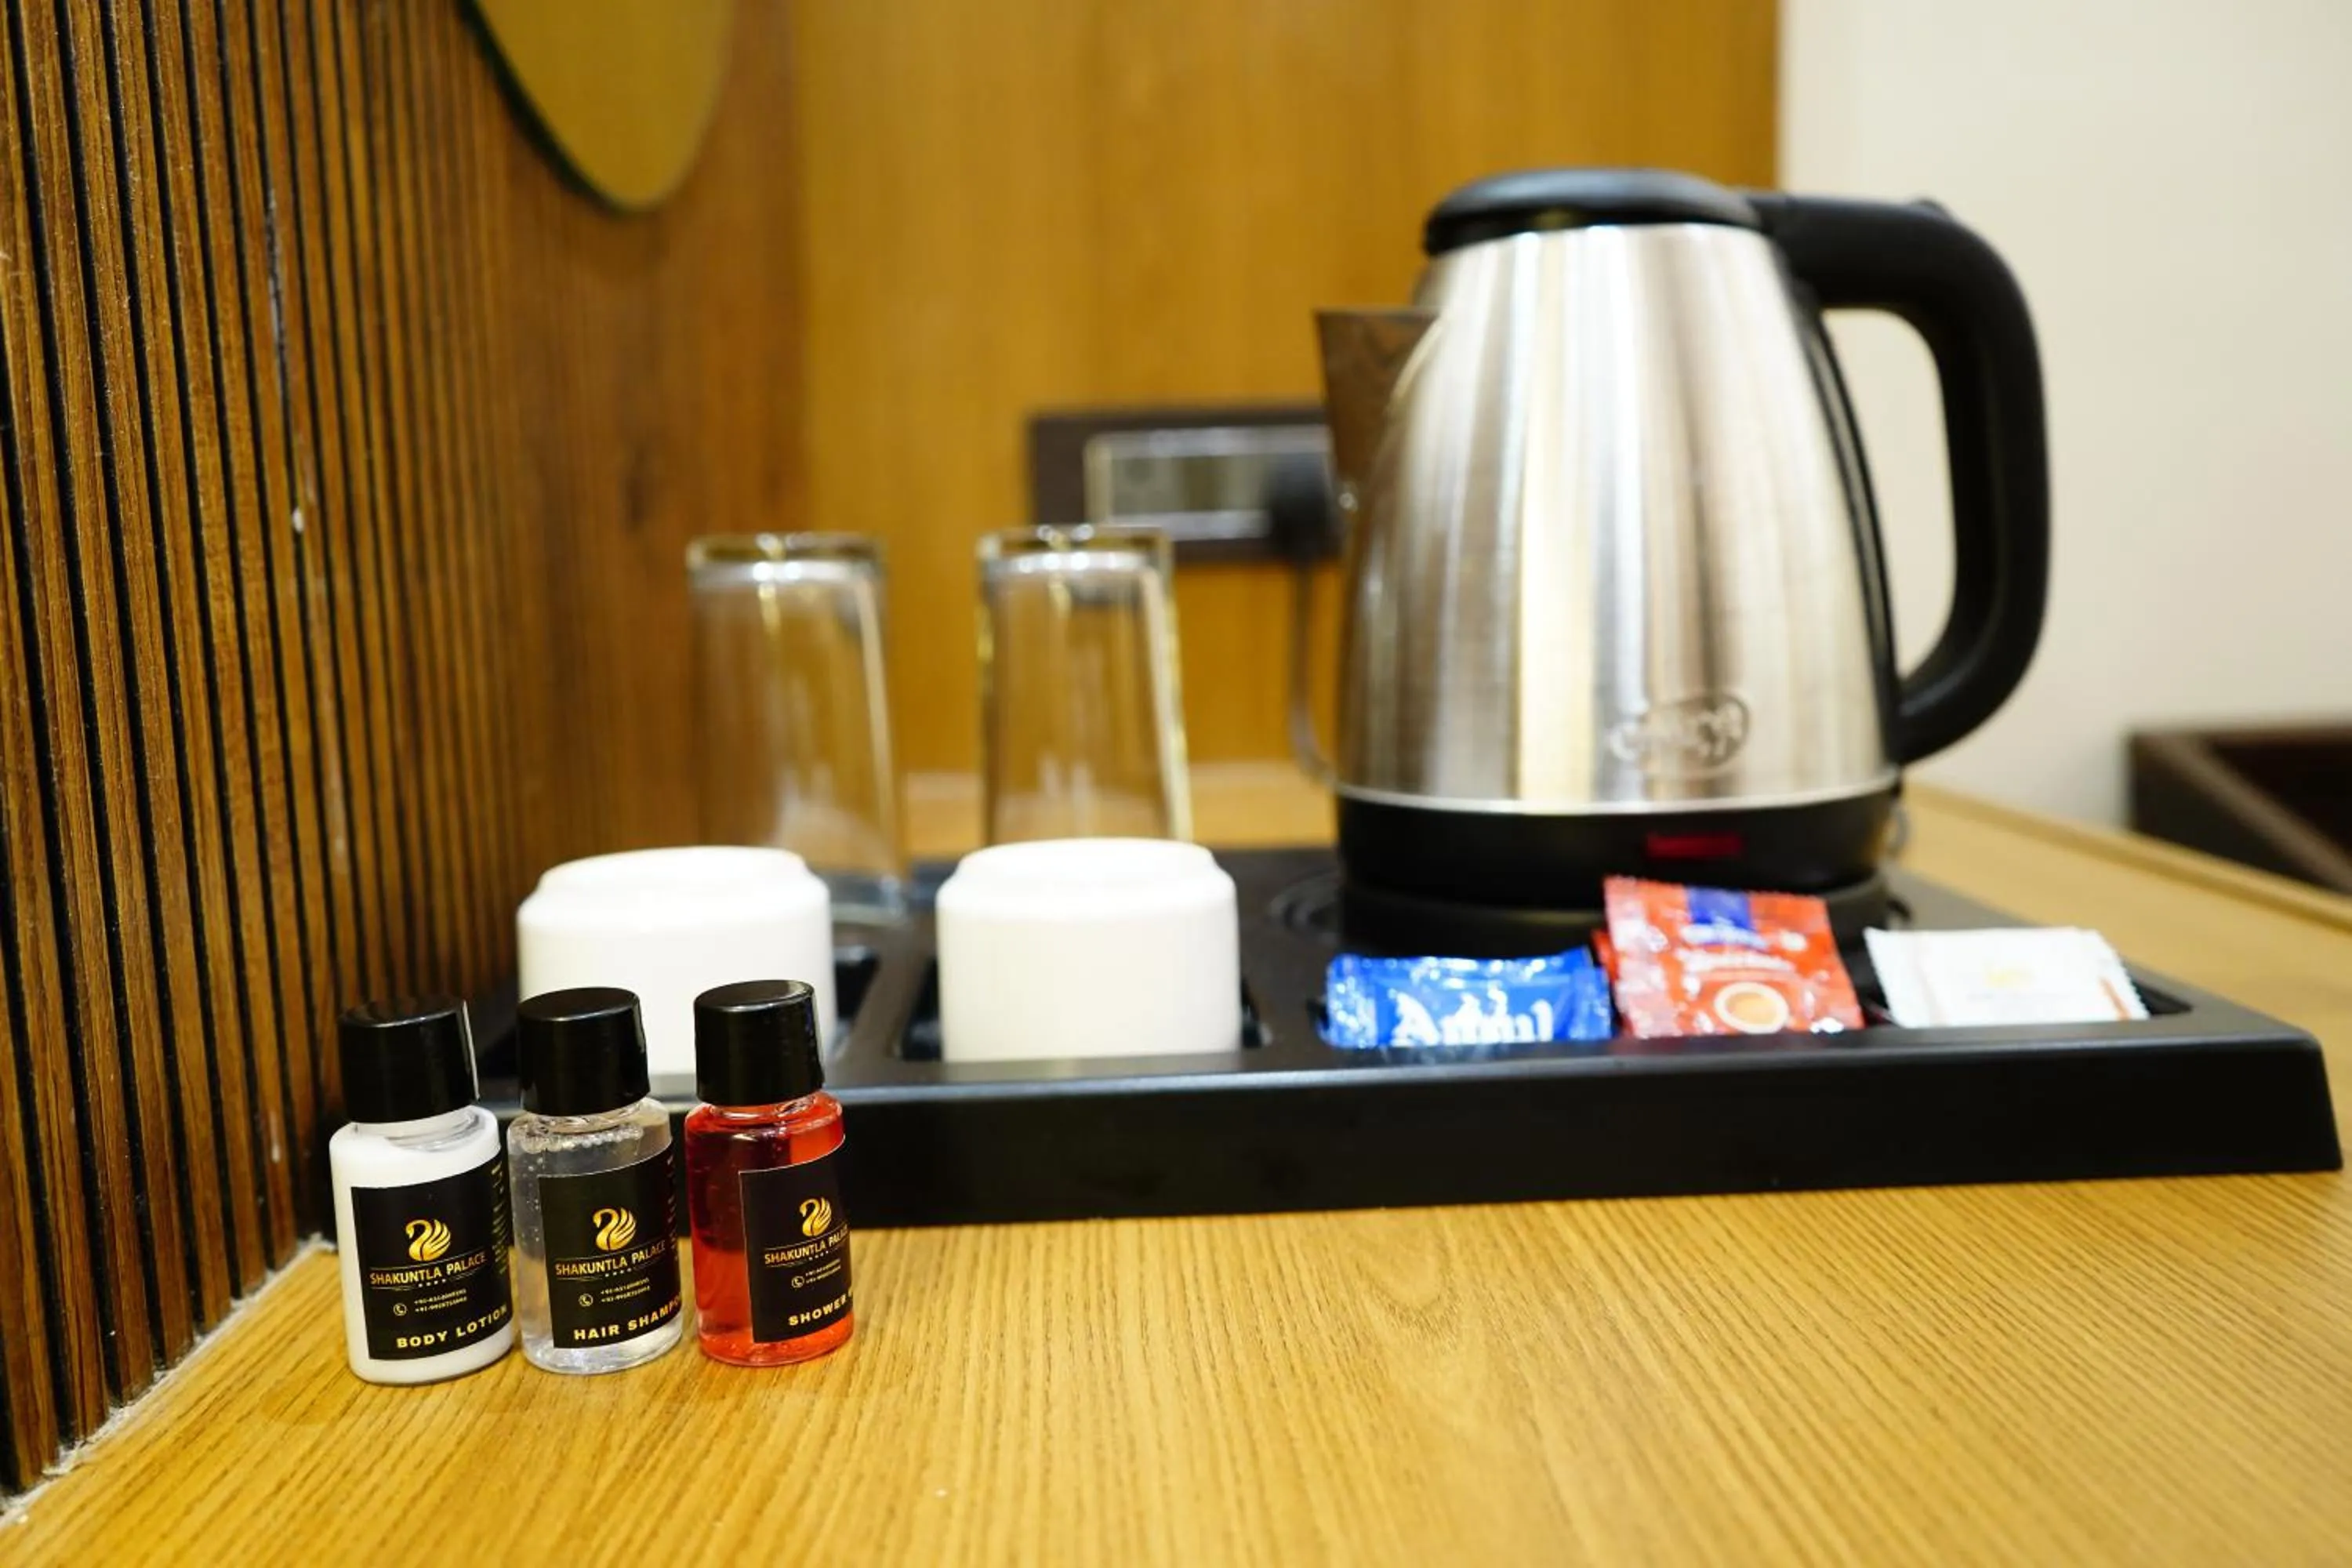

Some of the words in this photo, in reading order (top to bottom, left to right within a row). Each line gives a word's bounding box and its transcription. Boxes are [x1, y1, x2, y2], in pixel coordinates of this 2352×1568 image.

[554, 1256, 628, 1276] SHAKUNTLA
[631, 1240, 666, 1265] PALACE
[764, 1240, 826, 1265] SHAKUNTLA
[369, 1266, 442, 1285] SHAKUNTLA
[446, 1253, 488, 1276] PALACE
[396, 1330, 448, 1349] BODY
[456, 1304, 508, 1338] LOTION
[573, 1323, 620, 1341] HAIR
